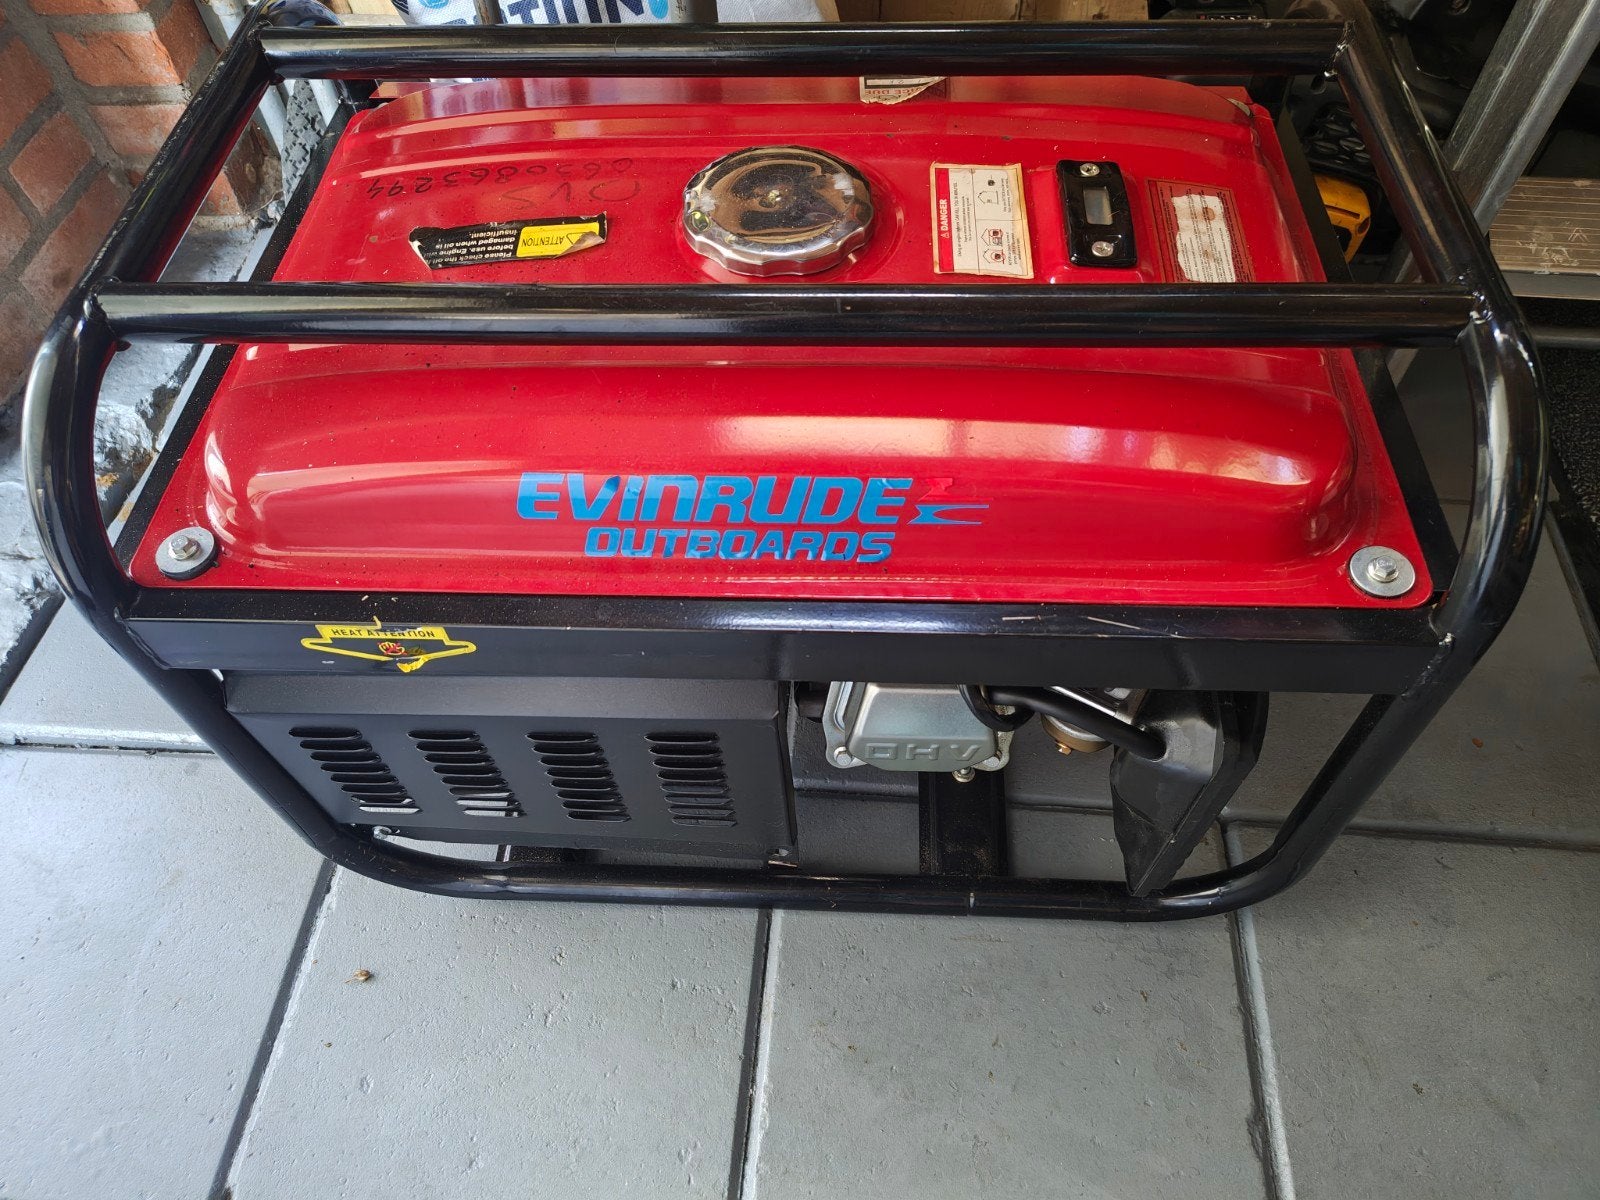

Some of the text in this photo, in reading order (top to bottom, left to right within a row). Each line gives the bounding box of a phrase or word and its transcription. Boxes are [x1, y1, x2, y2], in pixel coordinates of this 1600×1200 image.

[939, 198, 949, 231] DANGER
[478, 237, 516, 246] damaged
[521, 236, 565, 248] ATTENTION
[439, 248, 467, 256] Engine
[487, 244, 514, 253] before
[458, 253, 483, 261] check
[516, 471, 913, 525] EVINRUDE
[583, 526, 896, 563] OUTBOARDS
[330, 628, 365, 637] HEAT
[864, 742, 982, 761] OHV
